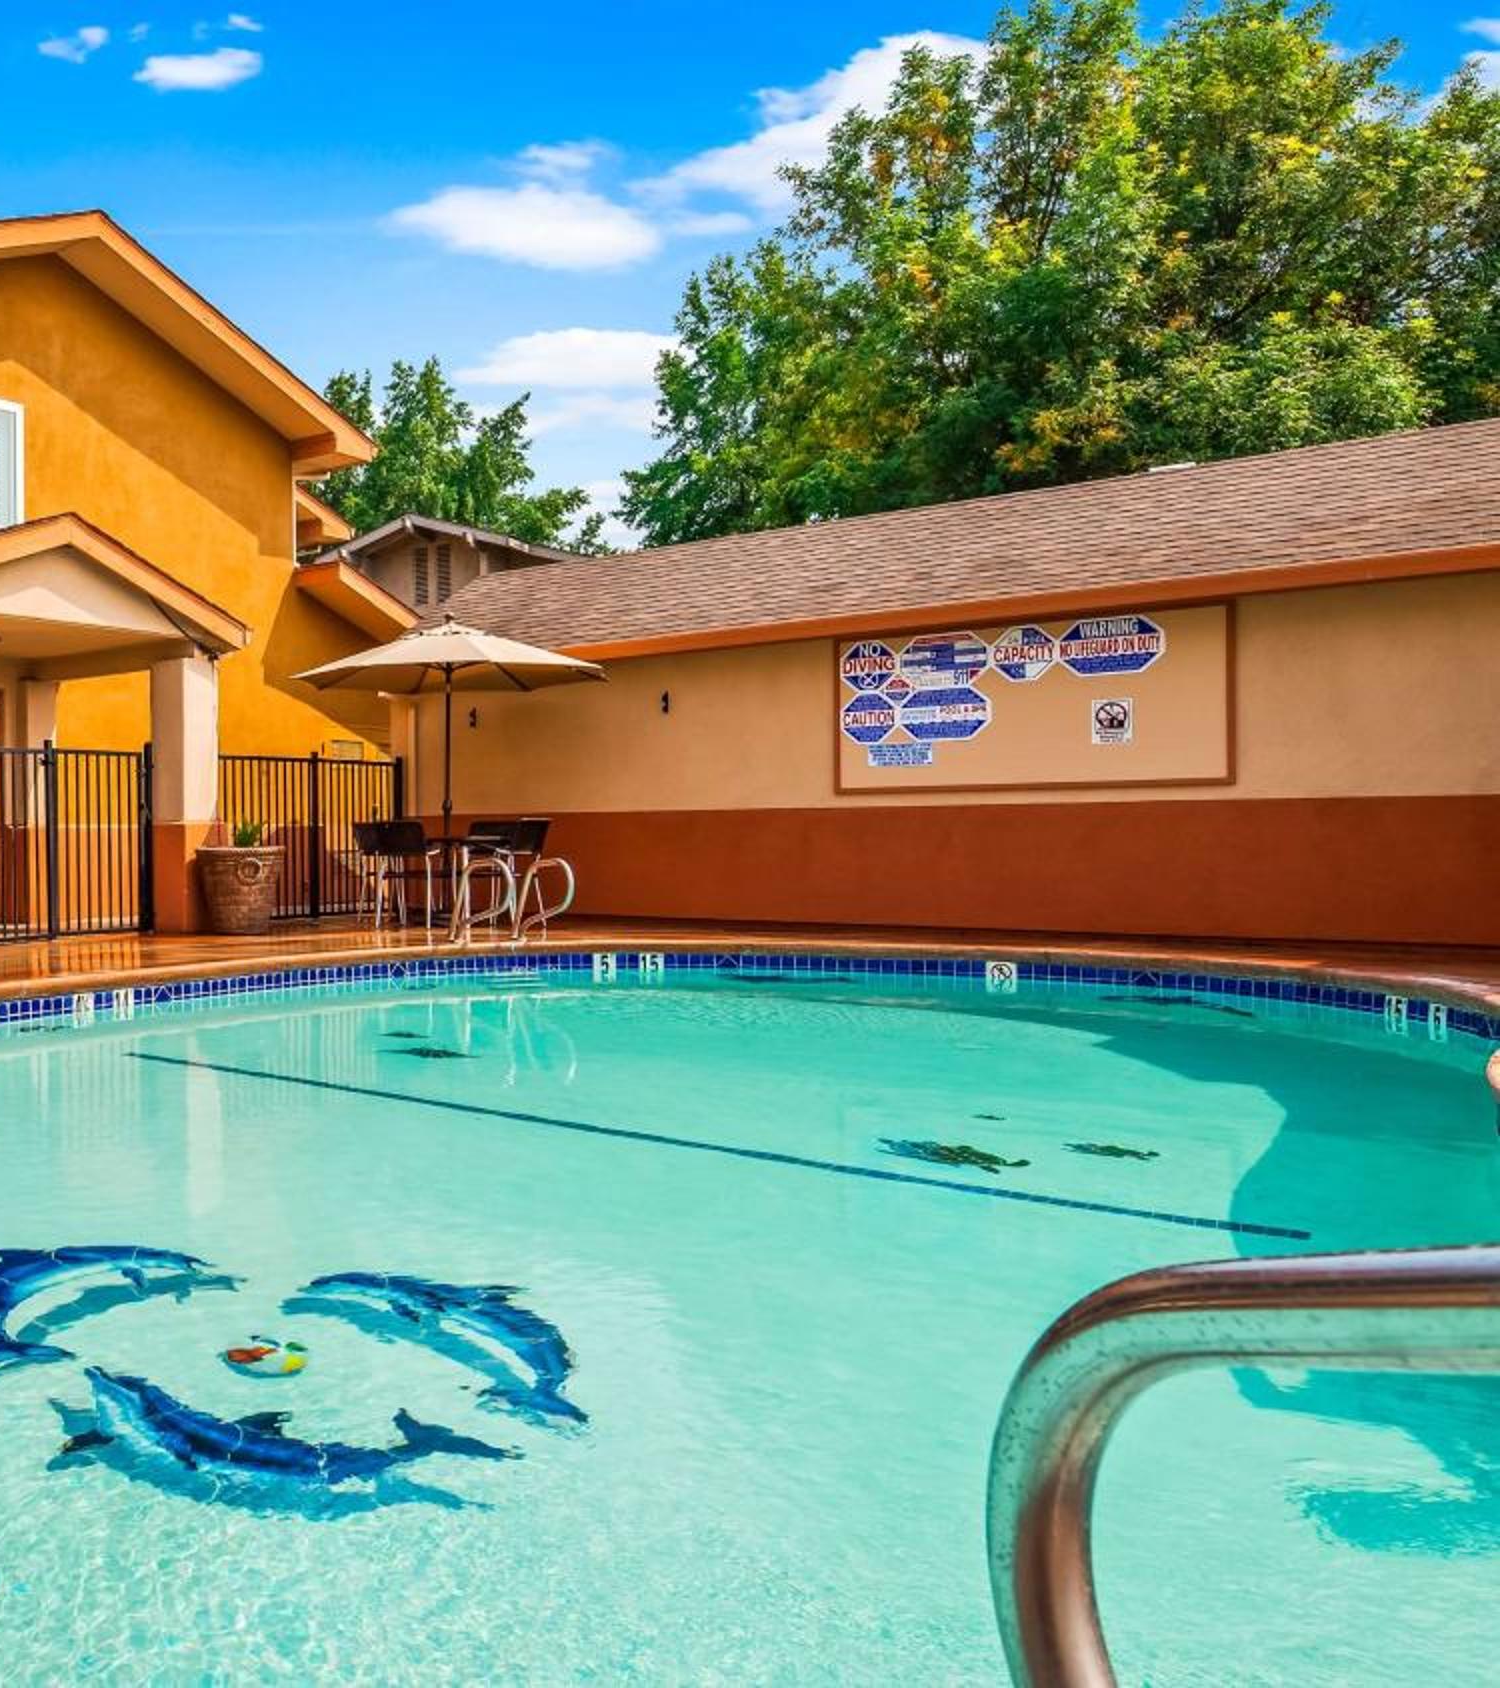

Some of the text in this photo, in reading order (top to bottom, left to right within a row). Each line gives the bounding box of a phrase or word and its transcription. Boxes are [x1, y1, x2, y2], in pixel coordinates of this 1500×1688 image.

[1080, 619, 1139, 638] WARNING
[860, 643, 880, 657] NO
[994, 643, 1054, 662] CAPACITY
[1060, 643, 1073, 659] NO
[1122, 637, 1135, 652] ON
[843, 657, 895, 675] DIVING
[954, 668, 968, 685] 911
[843, 711, 895, 726] CAUTION
